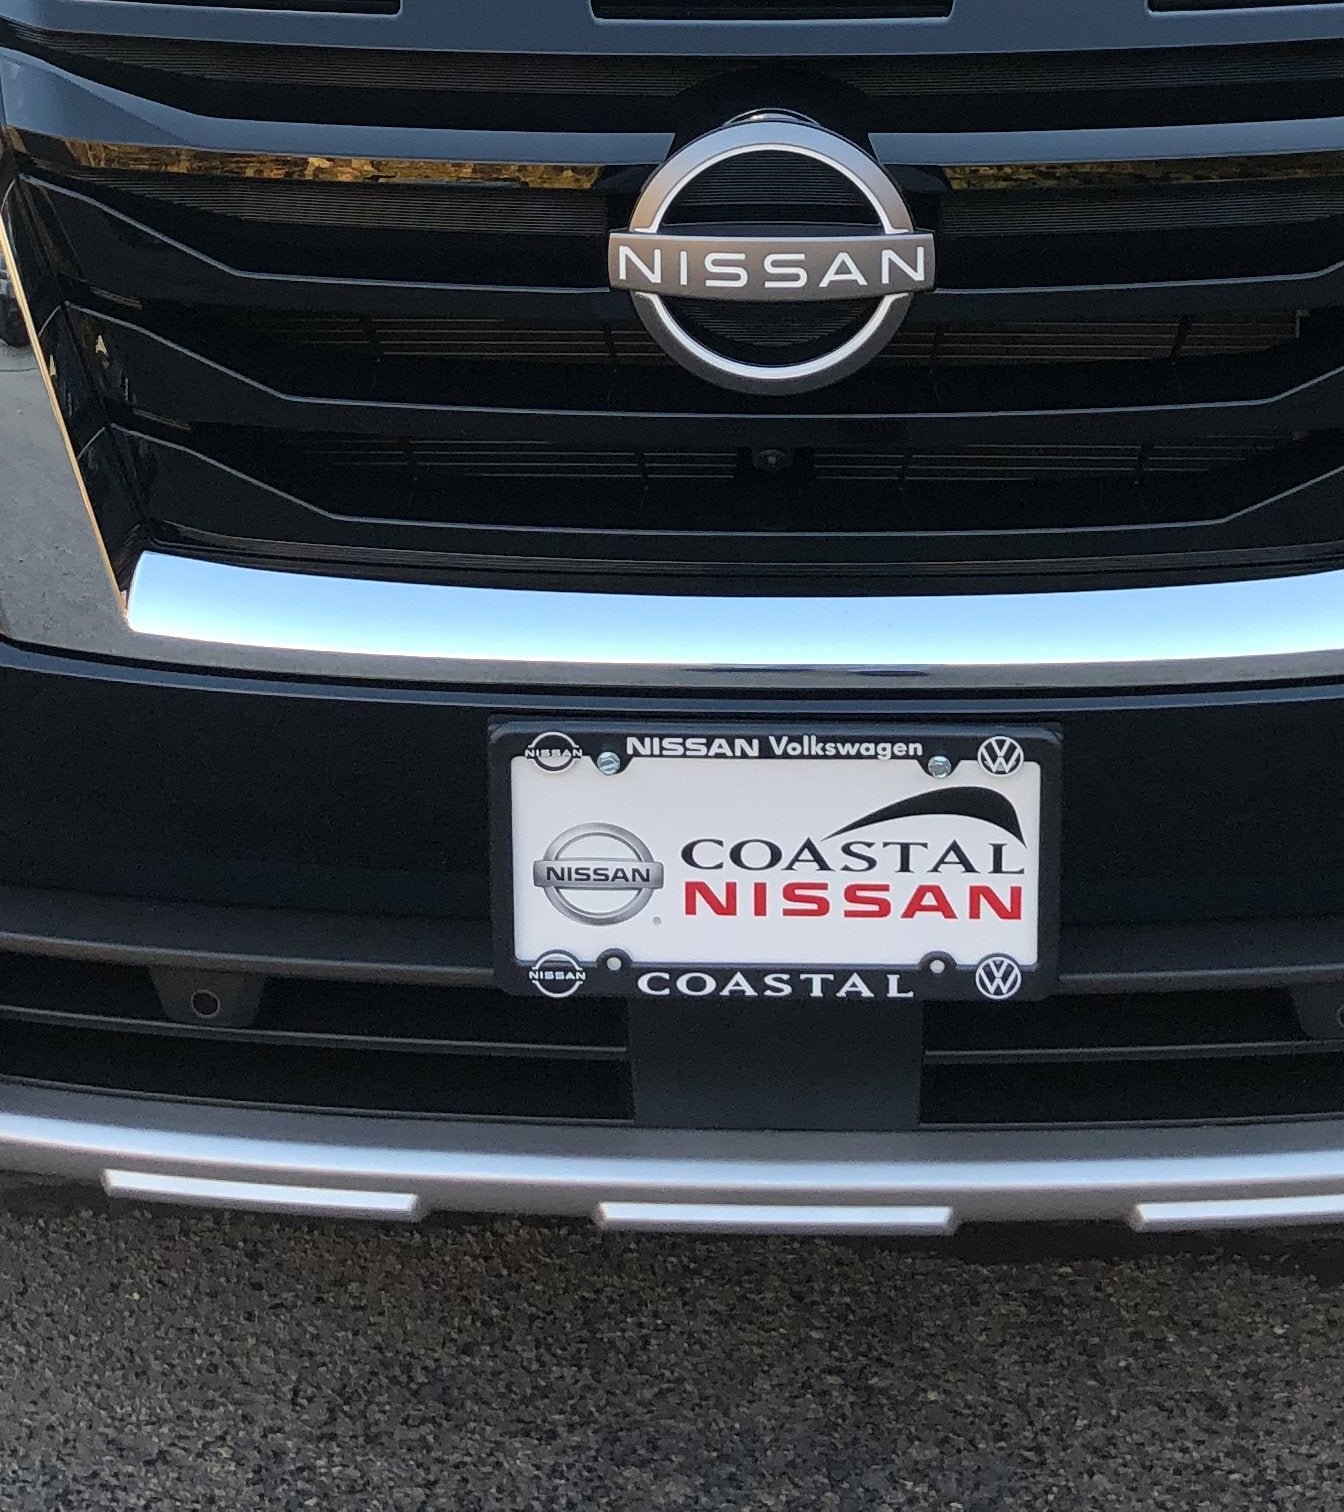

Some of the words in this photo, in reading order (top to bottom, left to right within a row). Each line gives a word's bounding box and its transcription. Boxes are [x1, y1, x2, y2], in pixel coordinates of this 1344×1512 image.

[618, 245, 925, 288] NISSAN
[524, 748, 583, 758] NISSAN
[626, 736, 759, 757] NISSAN
[768, 735, 923, 760] Volkswagen
[680, 837, 1025, 876] COASTAL
[546, 866, 651, 883] NISSAN
[684, 881, 1023, 921] NISSAN
[528, 970, 586, 981] NISSAN
[637, 972, 914, 999] COASTAL
